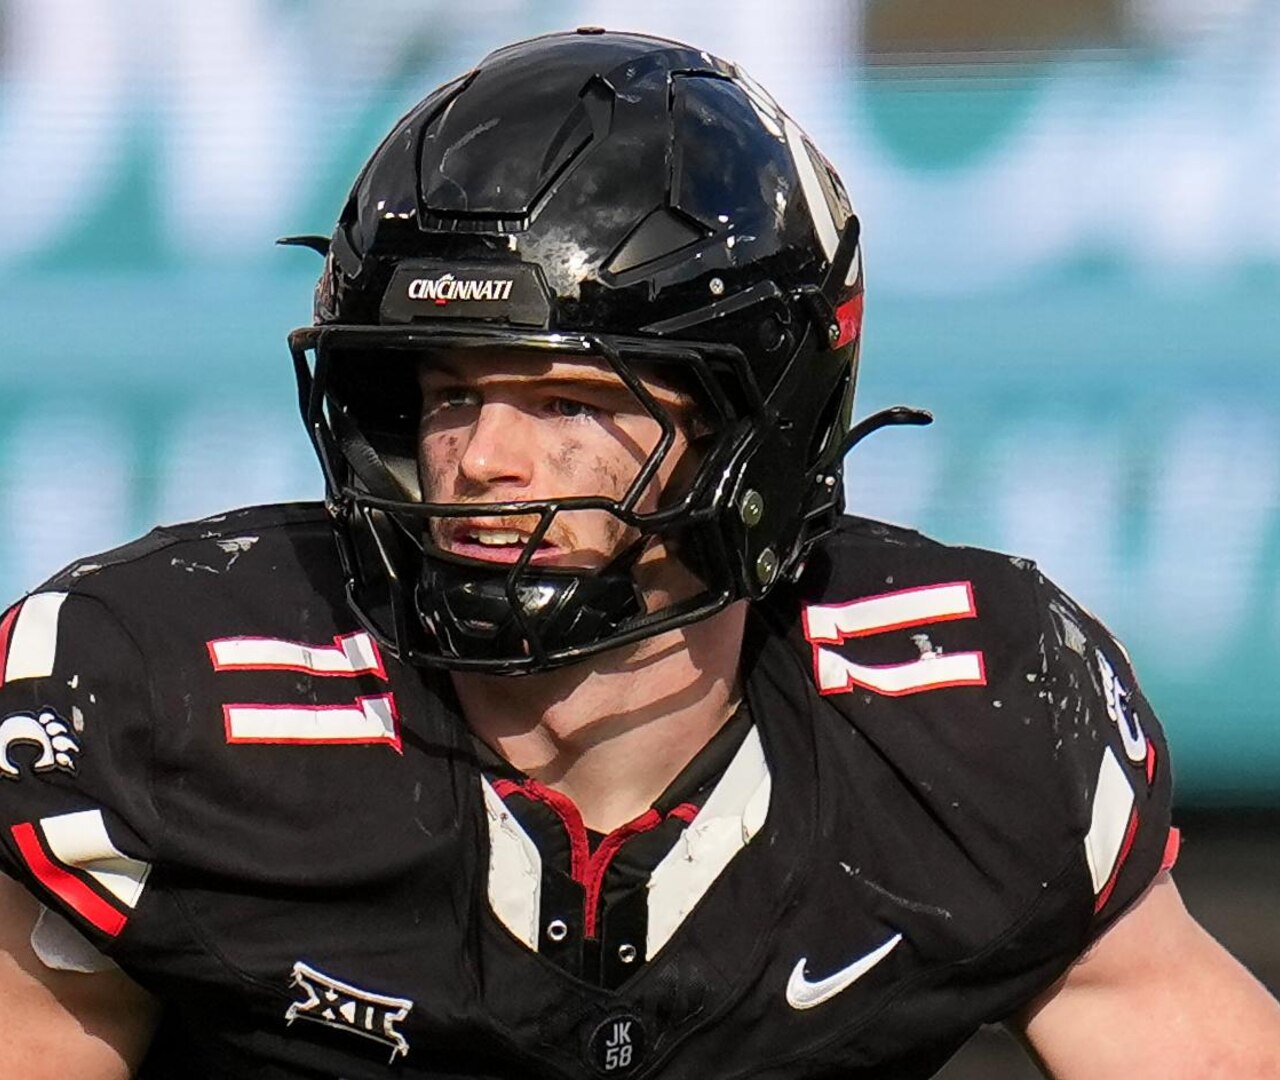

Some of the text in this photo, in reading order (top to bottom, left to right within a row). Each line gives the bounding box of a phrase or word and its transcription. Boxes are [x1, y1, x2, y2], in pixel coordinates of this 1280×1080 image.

[408, 274, 514, 304] CINCINNATI
[801, 580, 988, 697] 11
[206, 630, 404, 756] 11
[606, 1021, 632, 1047] JK
[605, 1045, 633, 1071] 58
